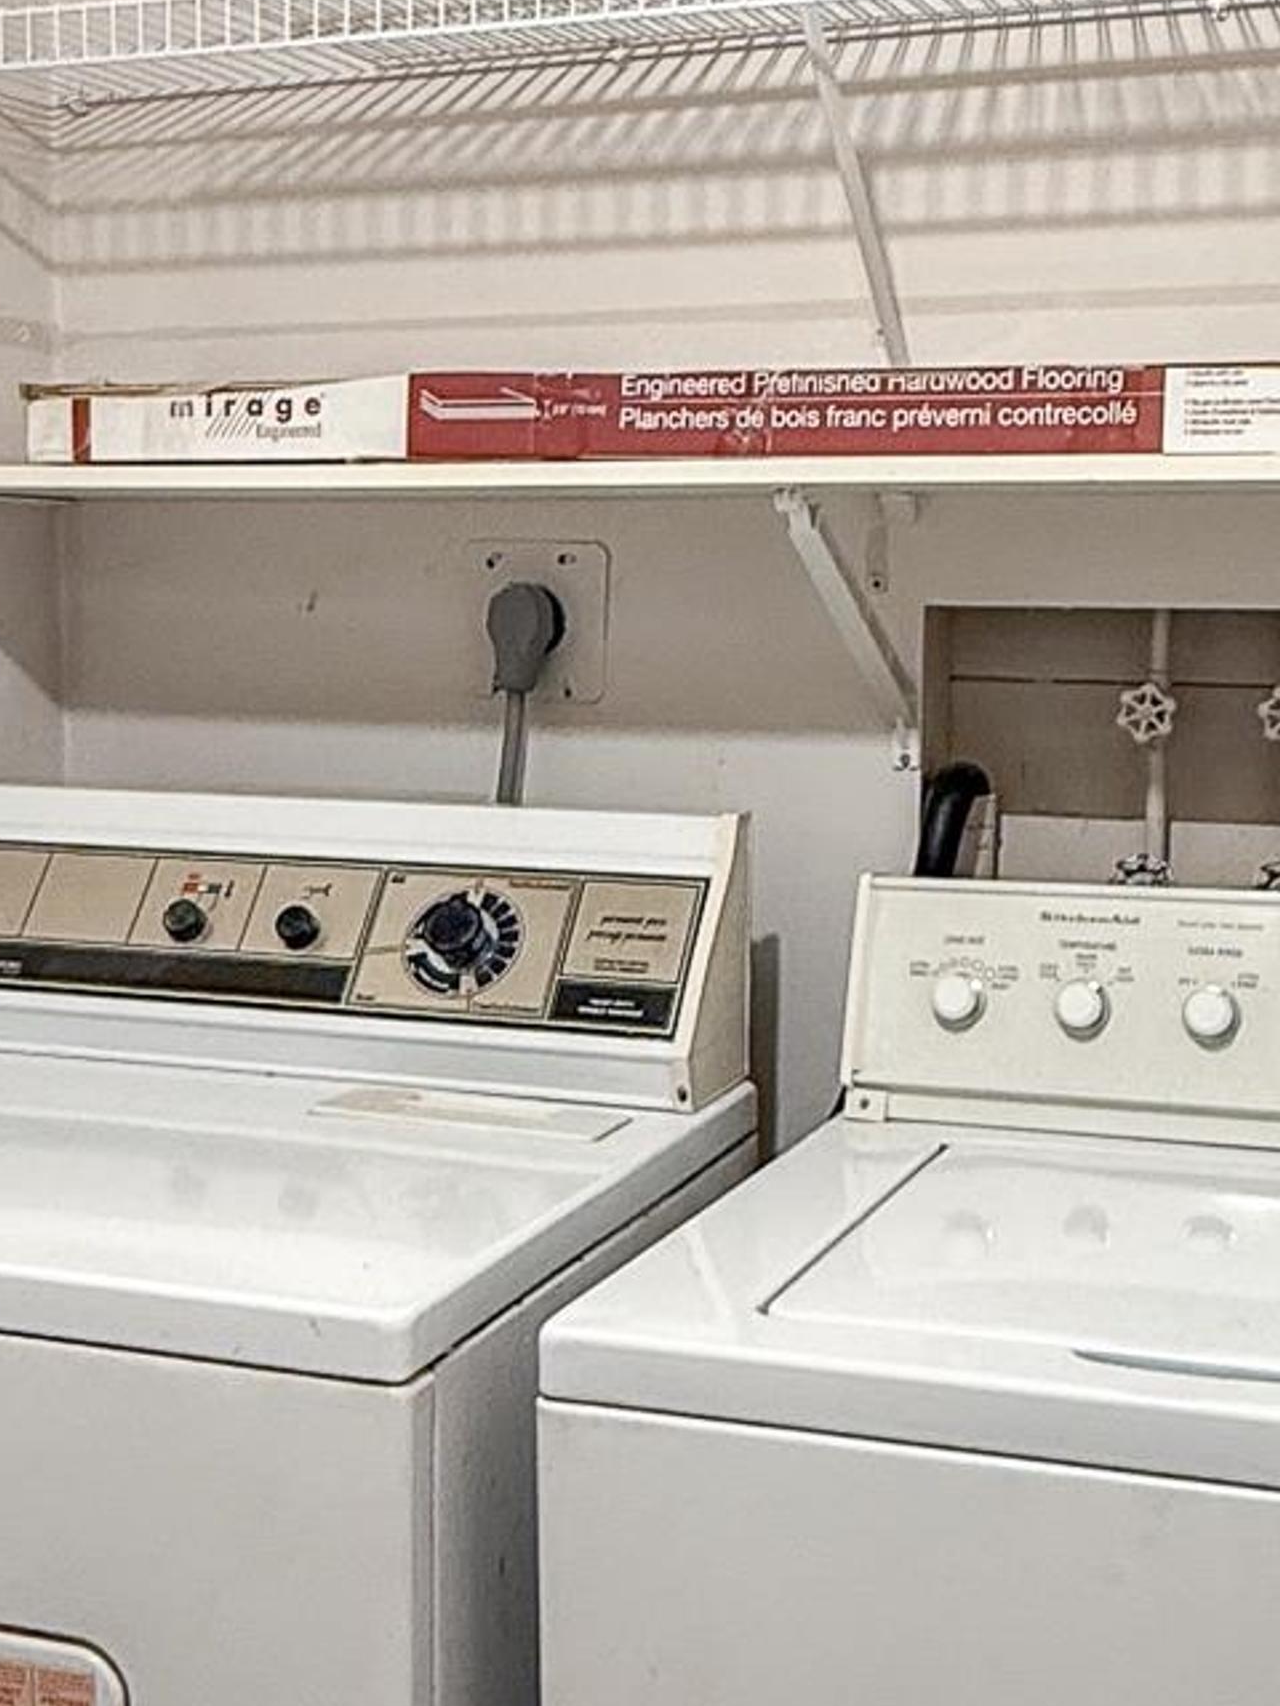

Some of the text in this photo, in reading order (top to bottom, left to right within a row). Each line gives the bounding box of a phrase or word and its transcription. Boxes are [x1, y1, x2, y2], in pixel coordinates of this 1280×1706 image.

[620, 373, 746, 400] Engineered
[1022, 366, 1124, 393] Flooring
[170, 394, 321, 423] mirage
[619, 405, 729, 430] Planchers
[736, 404, 764, 429] de
[771, 404, 820, 428] bois
[826, 404, 886, 428] franc
[892, 401, 991, 432] préverni
[997, 399, 1137, 426] contrecollé
